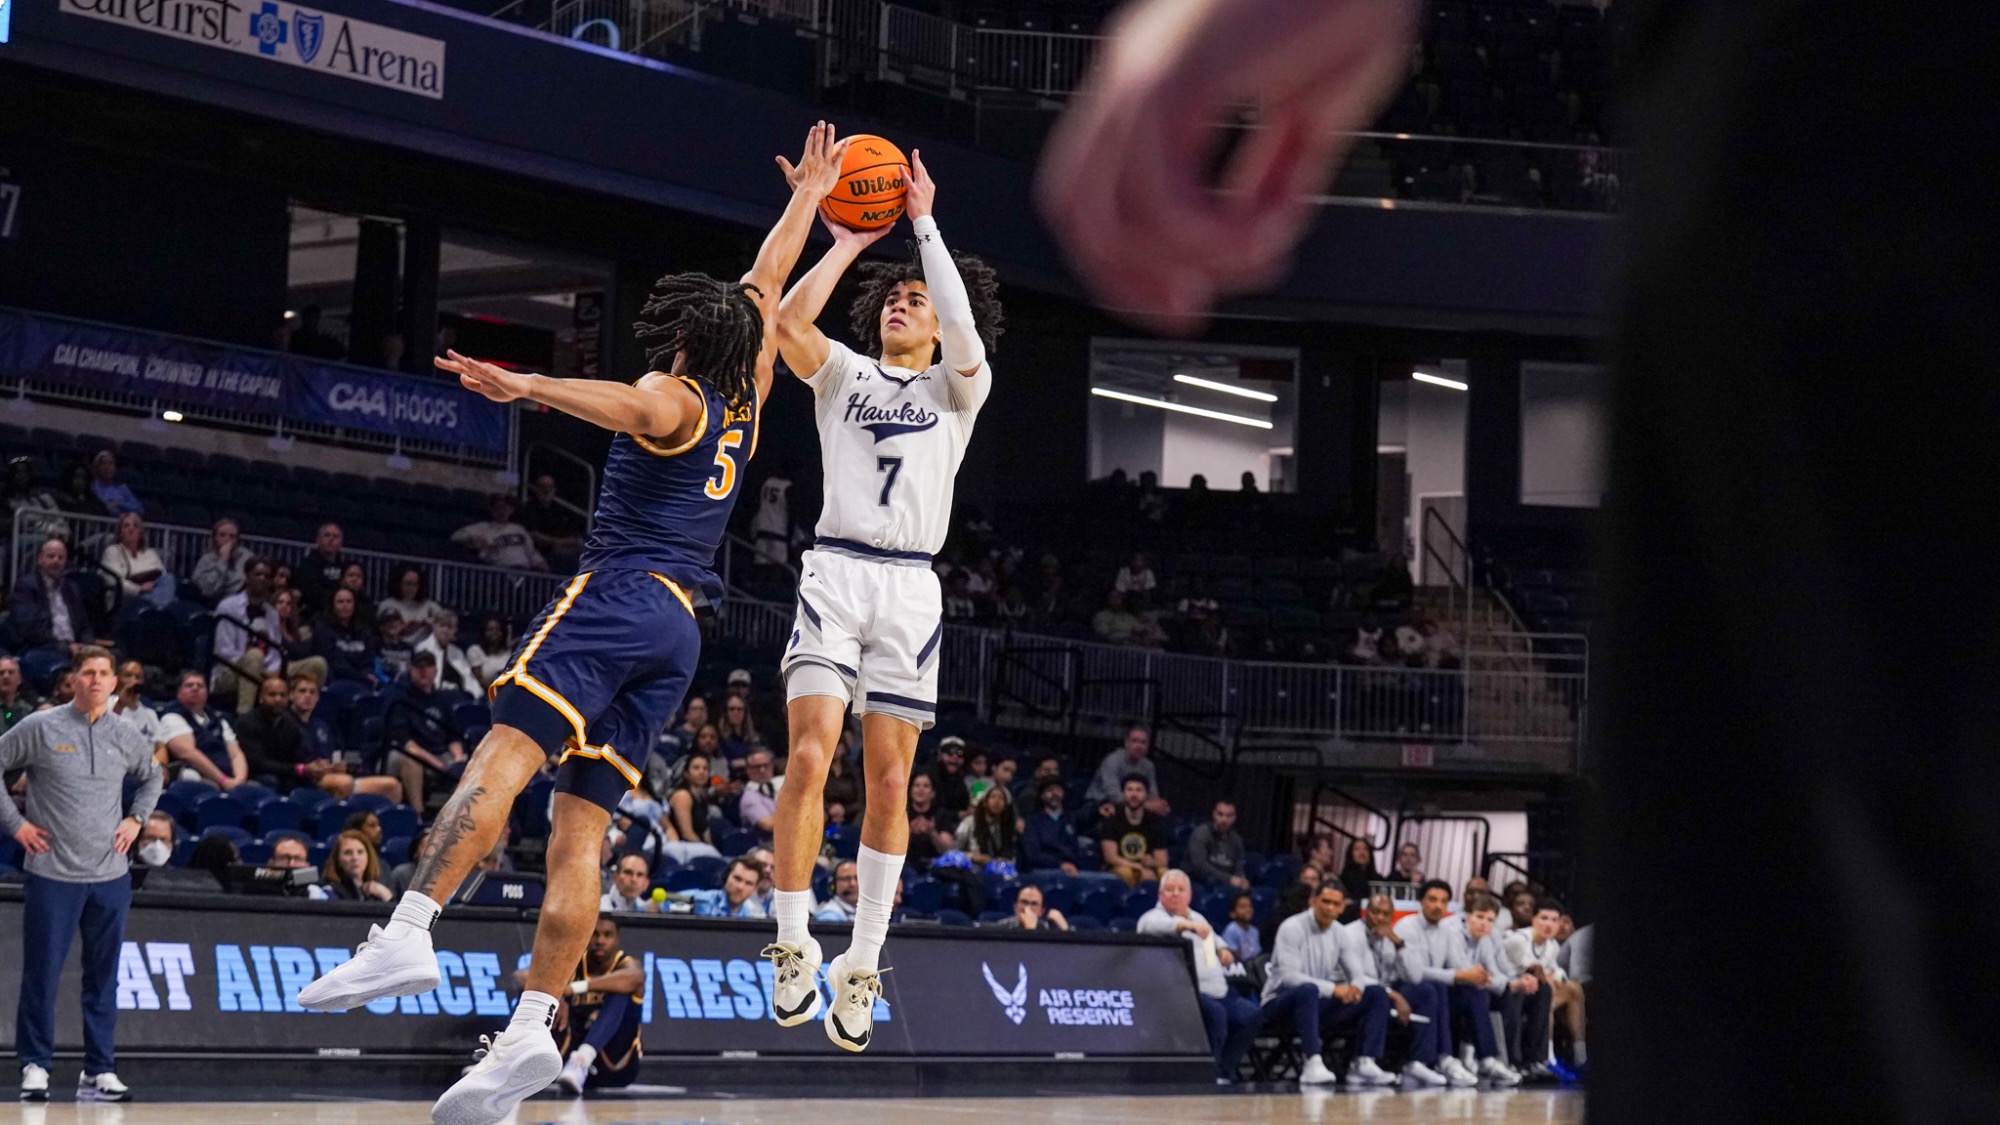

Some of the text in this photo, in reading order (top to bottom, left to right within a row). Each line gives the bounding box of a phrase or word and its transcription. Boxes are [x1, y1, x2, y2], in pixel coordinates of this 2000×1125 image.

[69, 0, 439, 93] areFirst Arena
[328, 382, 458, 428] CAA HOOPS
[843, 393, 928, 423] Hawks
[704, 429, 743, 500] 5
[877, 455, 903, 507] 7
[502, 884, 524, 899] POSS
[215, 944, 511, 1016] AIRCE
[1039, 988, 1135, 1008] AIR FORCE
[1047, 1007, 1134, 1026] RESERVE
